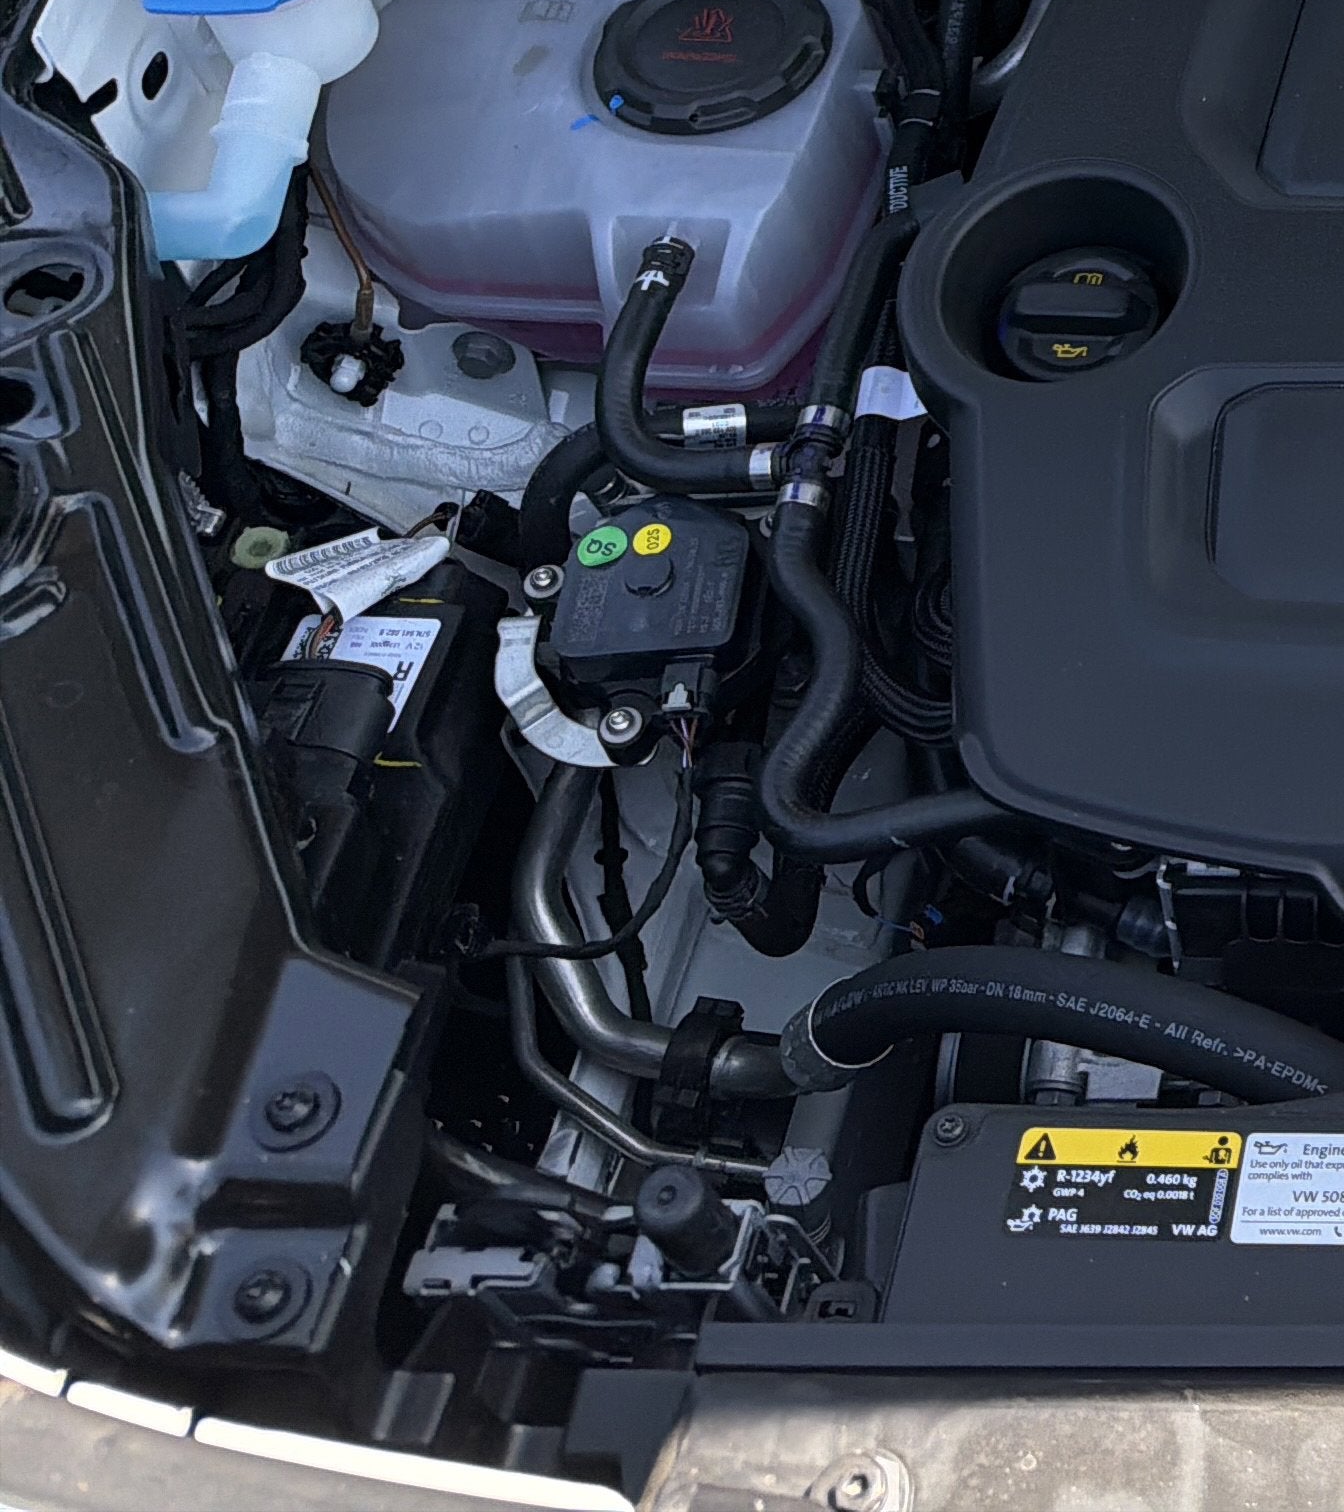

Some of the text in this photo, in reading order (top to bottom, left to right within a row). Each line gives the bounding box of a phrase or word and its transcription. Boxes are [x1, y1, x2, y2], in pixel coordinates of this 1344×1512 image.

[586, 538, 617, 557] SQ
[393, 661, 414, 682] R
[1008, 985, 1047, 1004] 18mm
[1056, 992, 1087, 1013] SAE
[1089, 1001, 1151, 1029] J2064-E
[1164, 1022, 1189, 1041] All
[1250, 1160, 1268, 1169] Use
[1269, 1160, 1289, 1171] only
[1291, 1160, 1303, 1169] oil
[1304, 1160, 1325, 1169] that
[1056, 1169, 1198, 1188] R-1234yf 0.460 kg
[1248, 1172, 1313, 1183] complies with
[1292, 1190, 1319, 1203] VW
[1048, 1208, 1078, 1222] PAG
[1242, 1207, 1257, 1216] For
[1258, 1209, 1265, 1217] a
[1267, 1207, 1281, 1217] list
[1284, 1207, 1296, 1217] of
[1295, 1208, 1341, 1219] approved
[1059, 1224, 1077, 1234] SAE
[1172, 1224, 1197, 1236] VW
[1197, 1225, 1218, 1237] AG
[1259, 1227, 1322, 1236] www.vw.com
